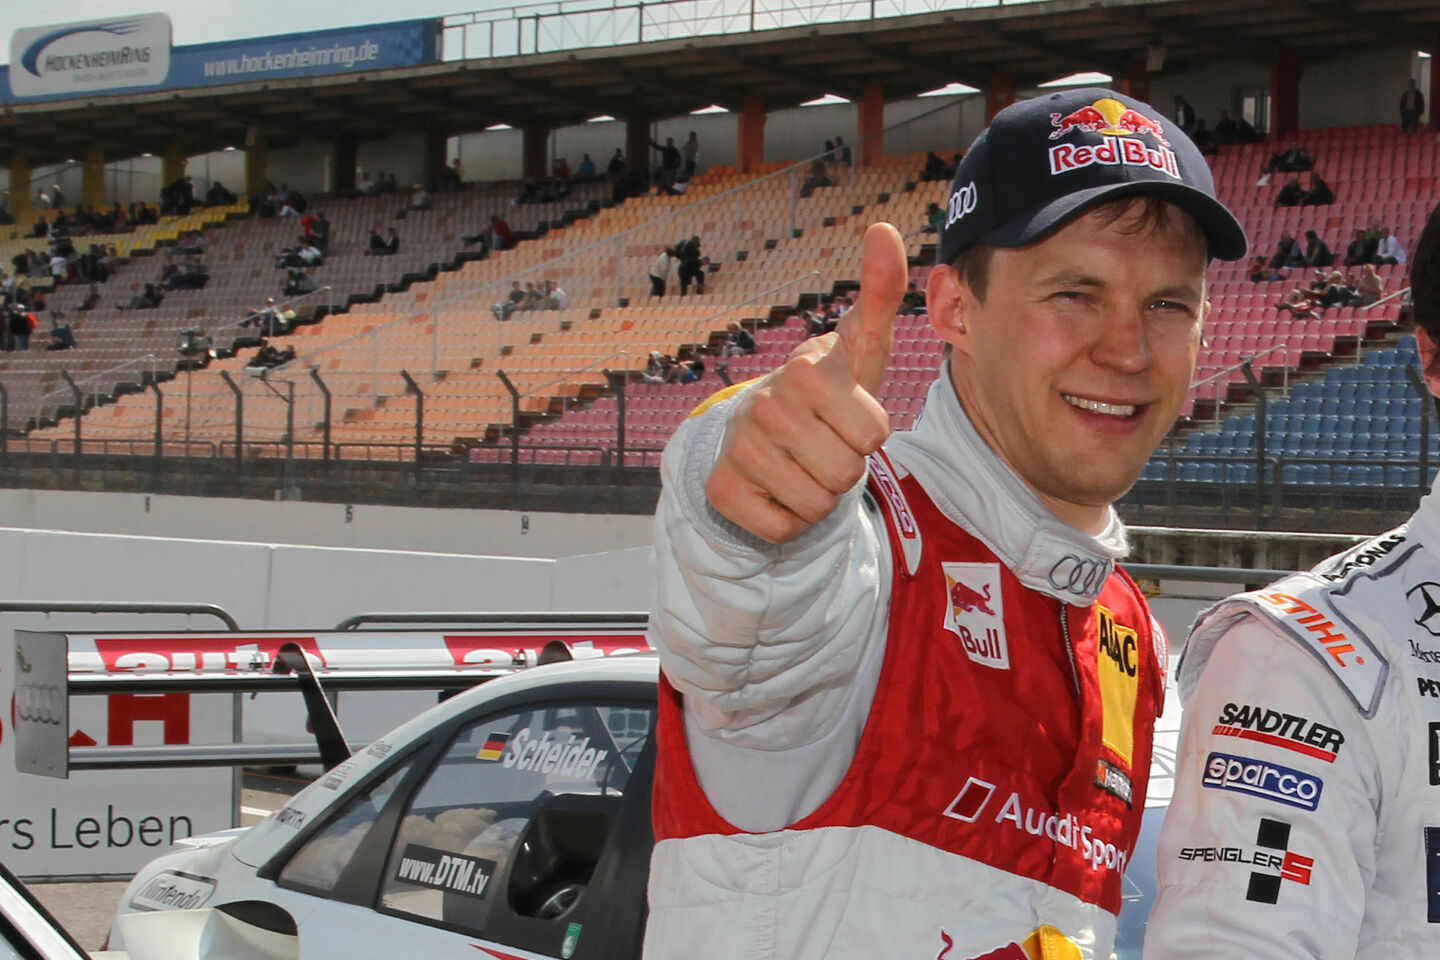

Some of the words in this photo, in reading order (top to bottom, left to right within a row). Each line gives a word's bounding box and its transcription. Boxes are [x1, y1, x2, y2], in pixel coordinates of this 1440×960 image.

[203, 40, 379, 77] www.hockenheimring.de
[1050, 137, 1120, 175] Red
[1119, 138, 1181, 179] Bull
[960, 626, 1002, 660] Bull
[1258, 593, 1357, 668] STIHL
[1219, 703, 1345, 753] SANDTLER
[503, 727, 608, 780] Scheider
[1208, 756, 1318, 801] sparco
[51, 805, 192, 849] Leben
[995, 792, 1079, 850] Audi
[398, 854, 490, 895] www.DTM.tv
[1178, 847, 1283, 871] SPENGLER
